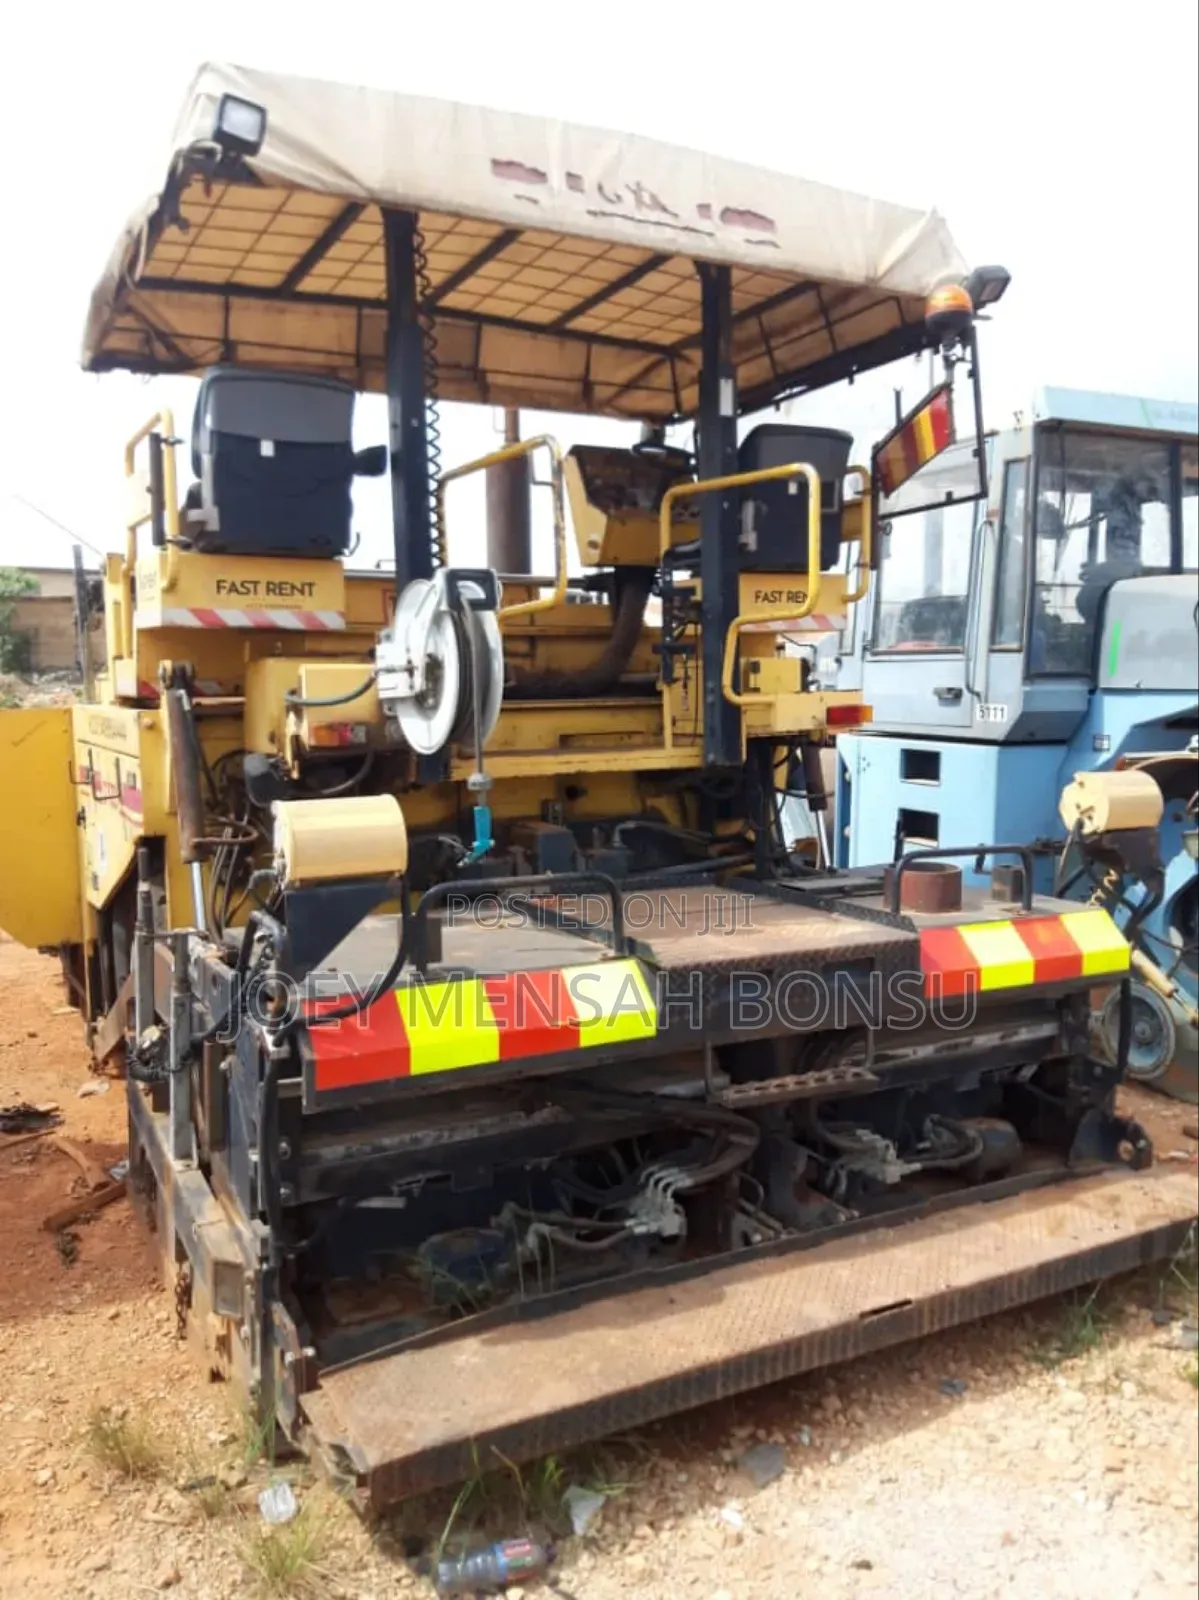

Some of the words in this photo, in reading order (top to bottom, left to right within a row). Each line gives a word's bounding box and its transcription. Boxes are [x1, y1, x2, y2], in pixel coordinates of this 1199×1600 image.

[215, 579, 260, 597] FAST
[265, 581, 316, 597] RENT
[754, 590, 783, 604] FAST
[786, 591, 809, 604] REN
